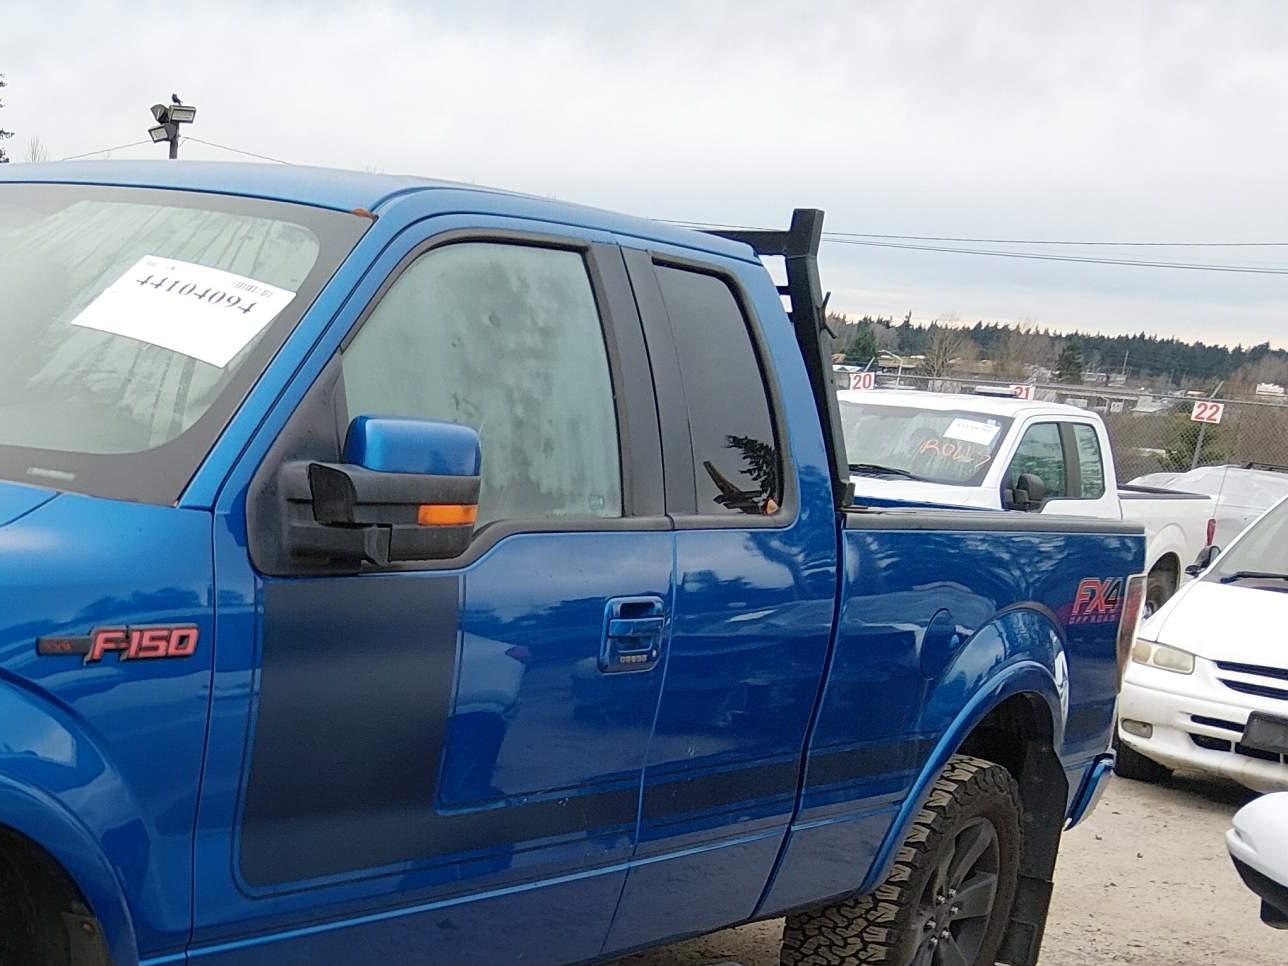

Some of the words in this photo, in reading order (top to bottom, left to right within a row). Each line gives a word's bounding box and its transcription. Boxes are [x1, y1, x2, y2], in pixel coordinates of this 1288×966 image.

[137, 274, 257, 314] 44104094
[853, 374, 872, 390] 20
[1015, 386, 1029, 399] 21
[1194, 402, 1220, 421] 22
[1072, 577, 1123, 615] FX4
[91, 628, 199, 661] F-150
